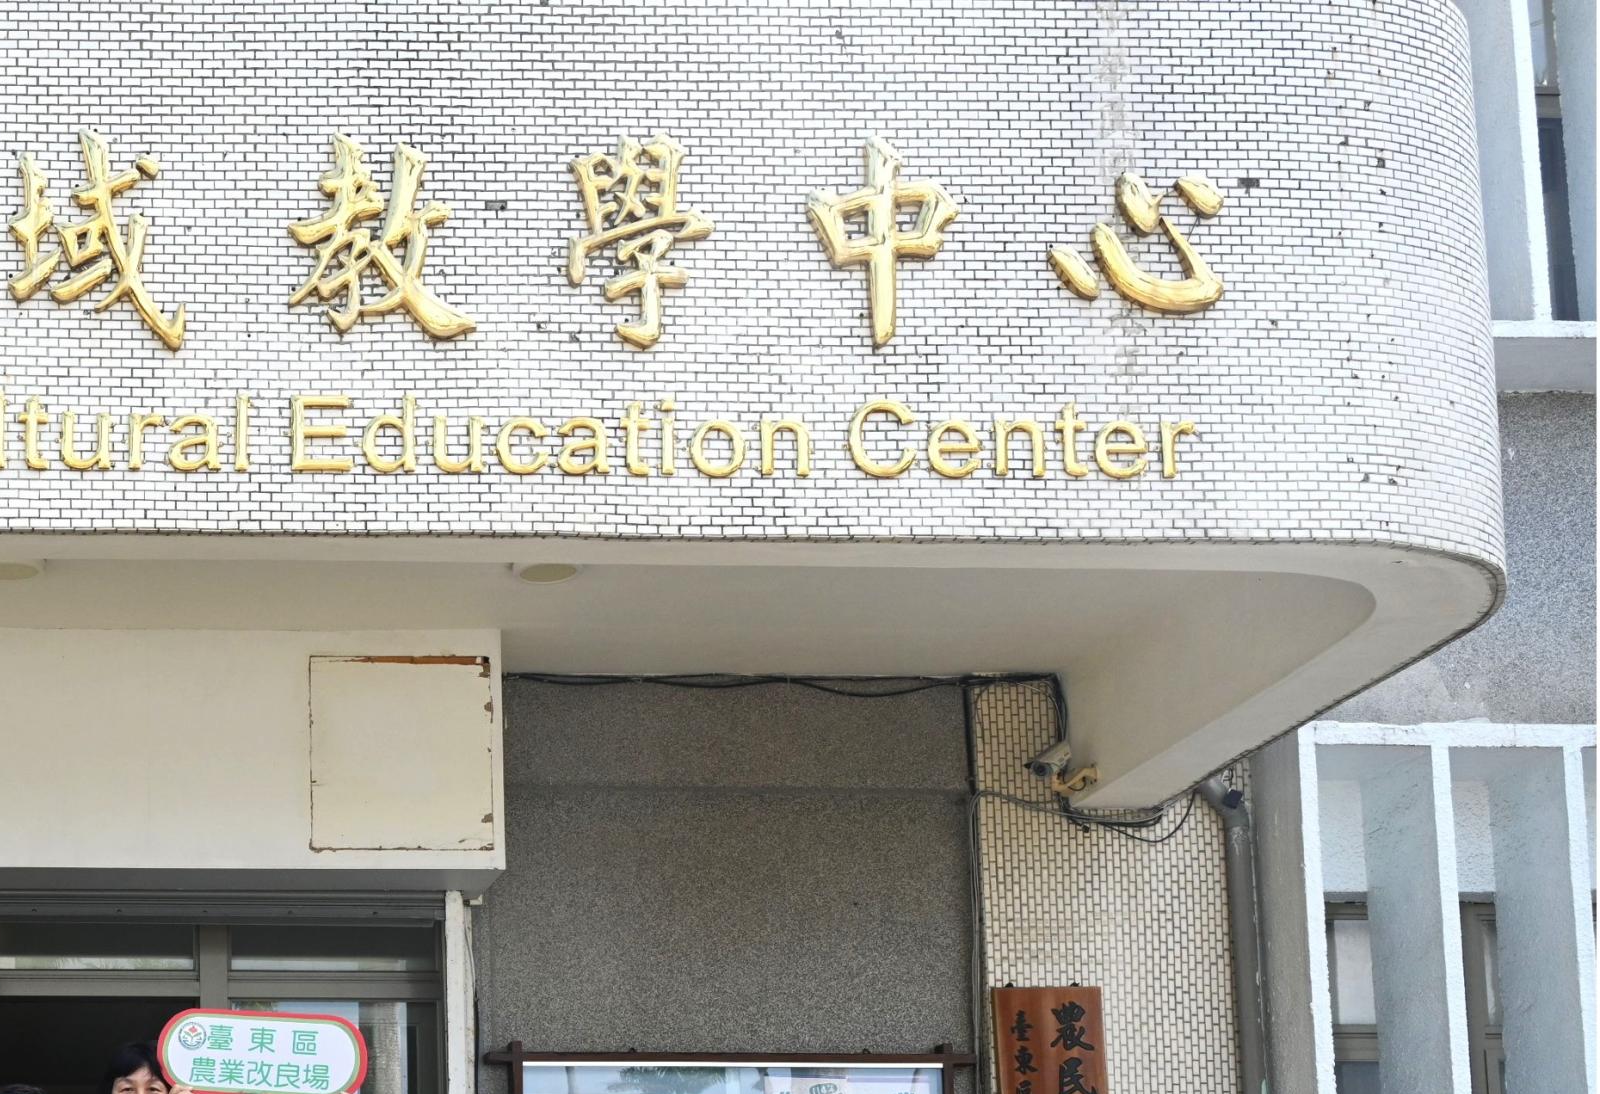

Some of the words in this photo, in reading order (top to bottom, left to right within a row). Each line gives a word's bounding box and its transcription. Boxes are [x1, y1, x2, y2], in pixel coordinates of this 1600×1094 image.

[290, 394, 810, 478] Education
[848, 400, 1198, 480] Center
[207, 1024, 320, 1056] 臺東區
[189, 1056, 330, 1091] 農業改良場
